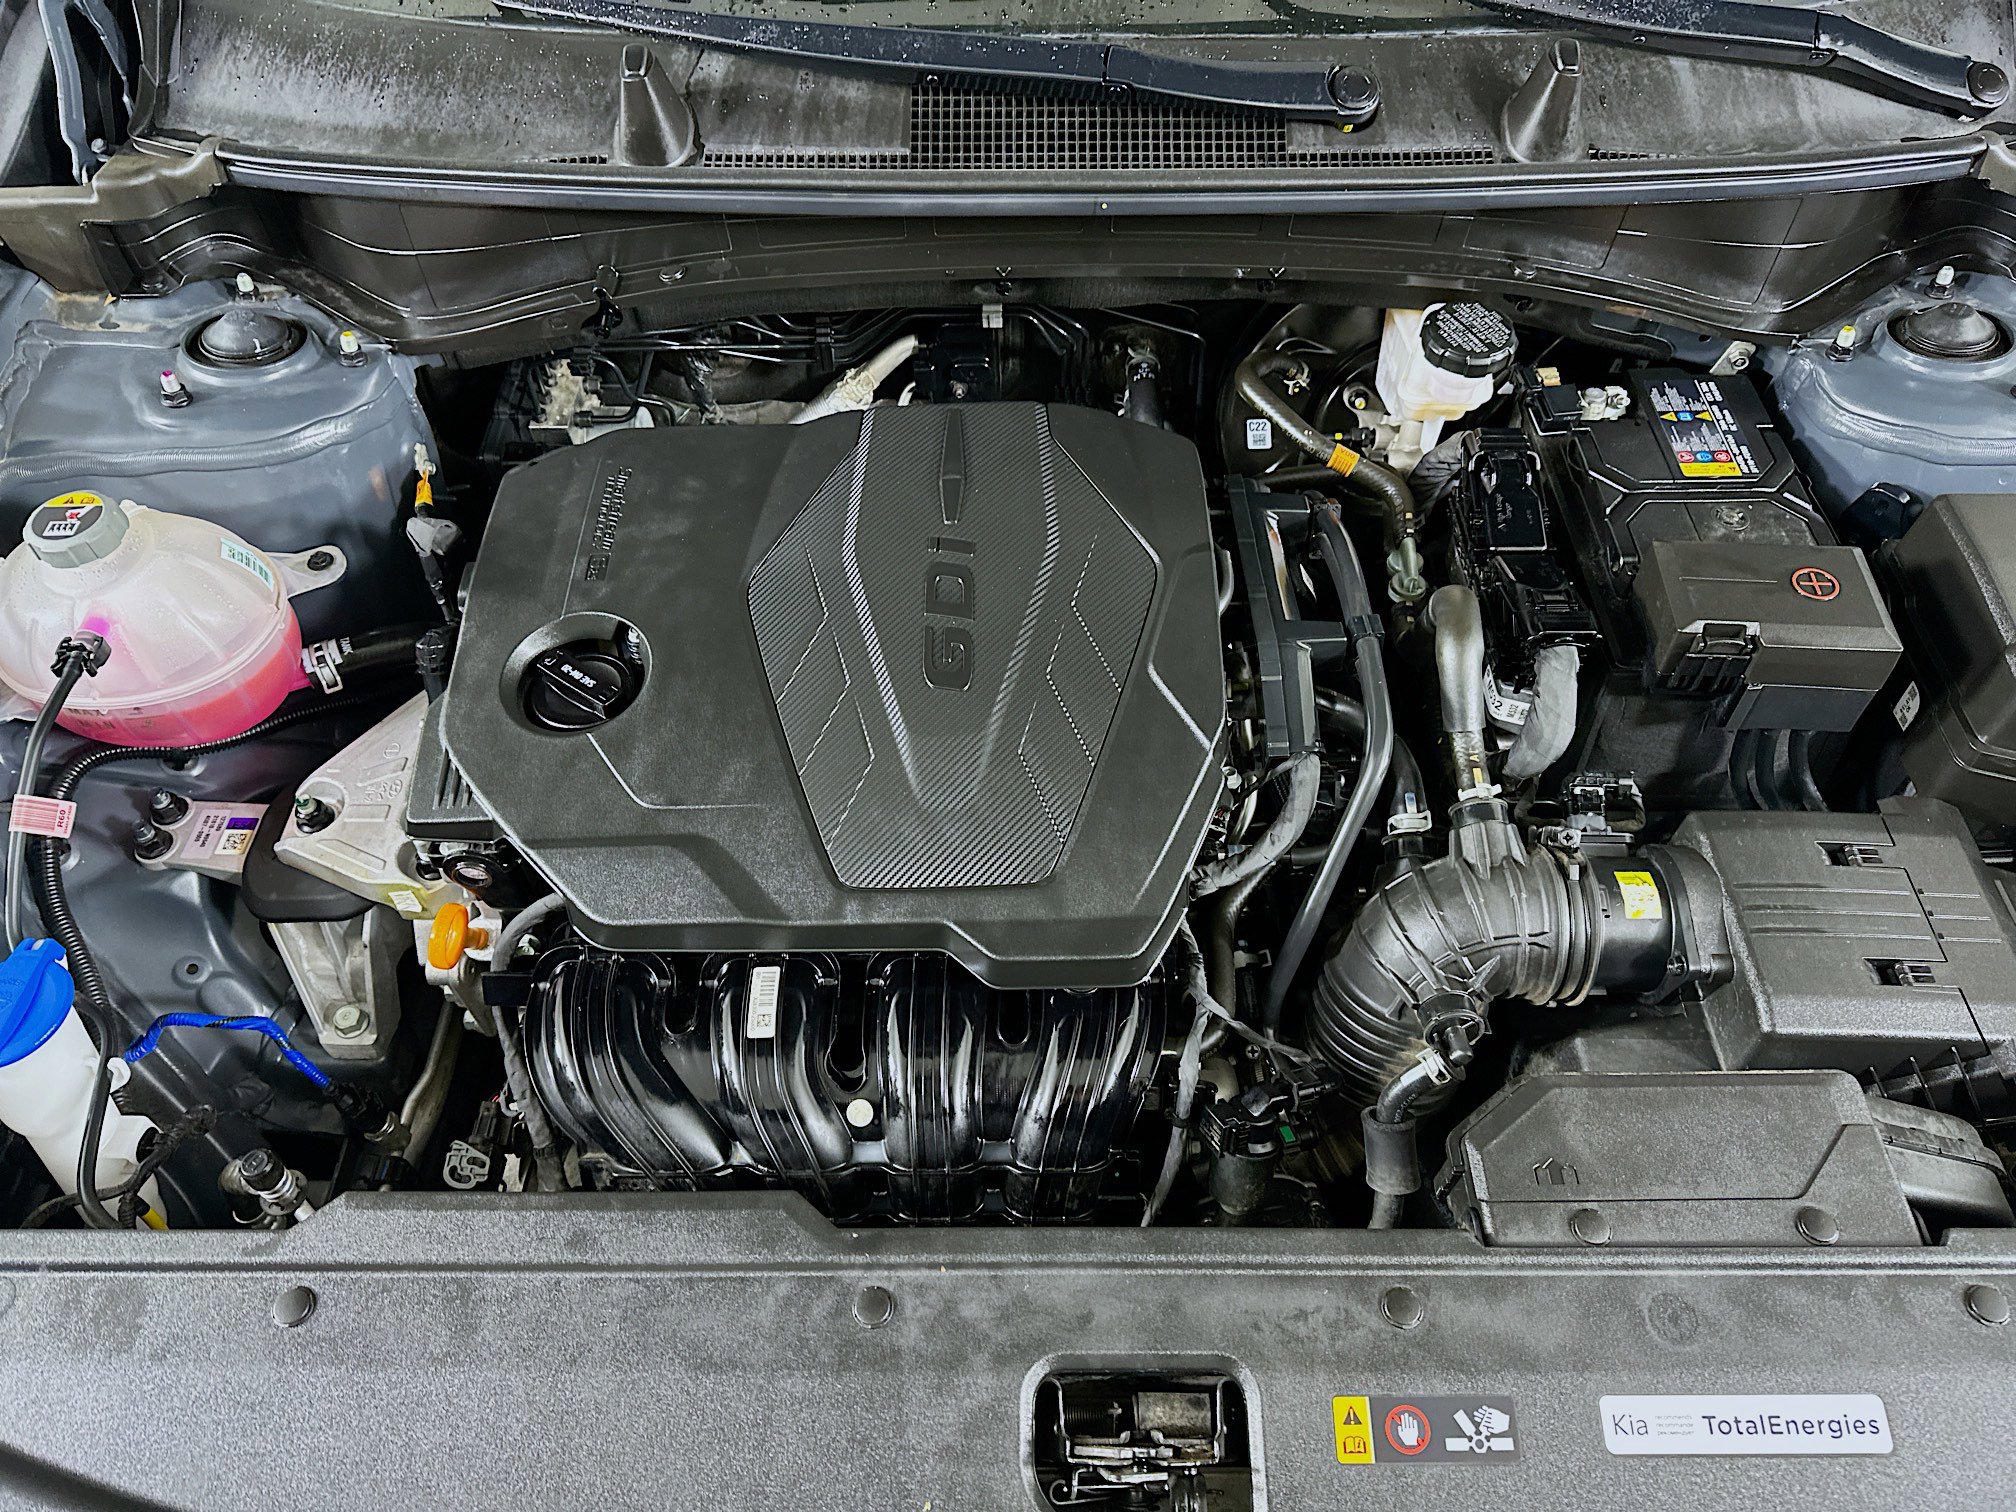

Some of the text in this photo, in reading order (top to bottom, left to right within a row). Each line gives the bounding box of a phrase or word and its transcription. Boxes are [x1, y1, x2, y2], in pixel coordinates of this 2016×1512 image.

[1248, 421, 1268, 432] C22
[602, 466, 633, 550] Smartstream
[579, 675, 597, 688] SAE
[56, 809, 66, 828] R60
[1611, 1413, 1649, 1437] Kia
[1701, 1414, 1881, 1440] TotalEnergies
